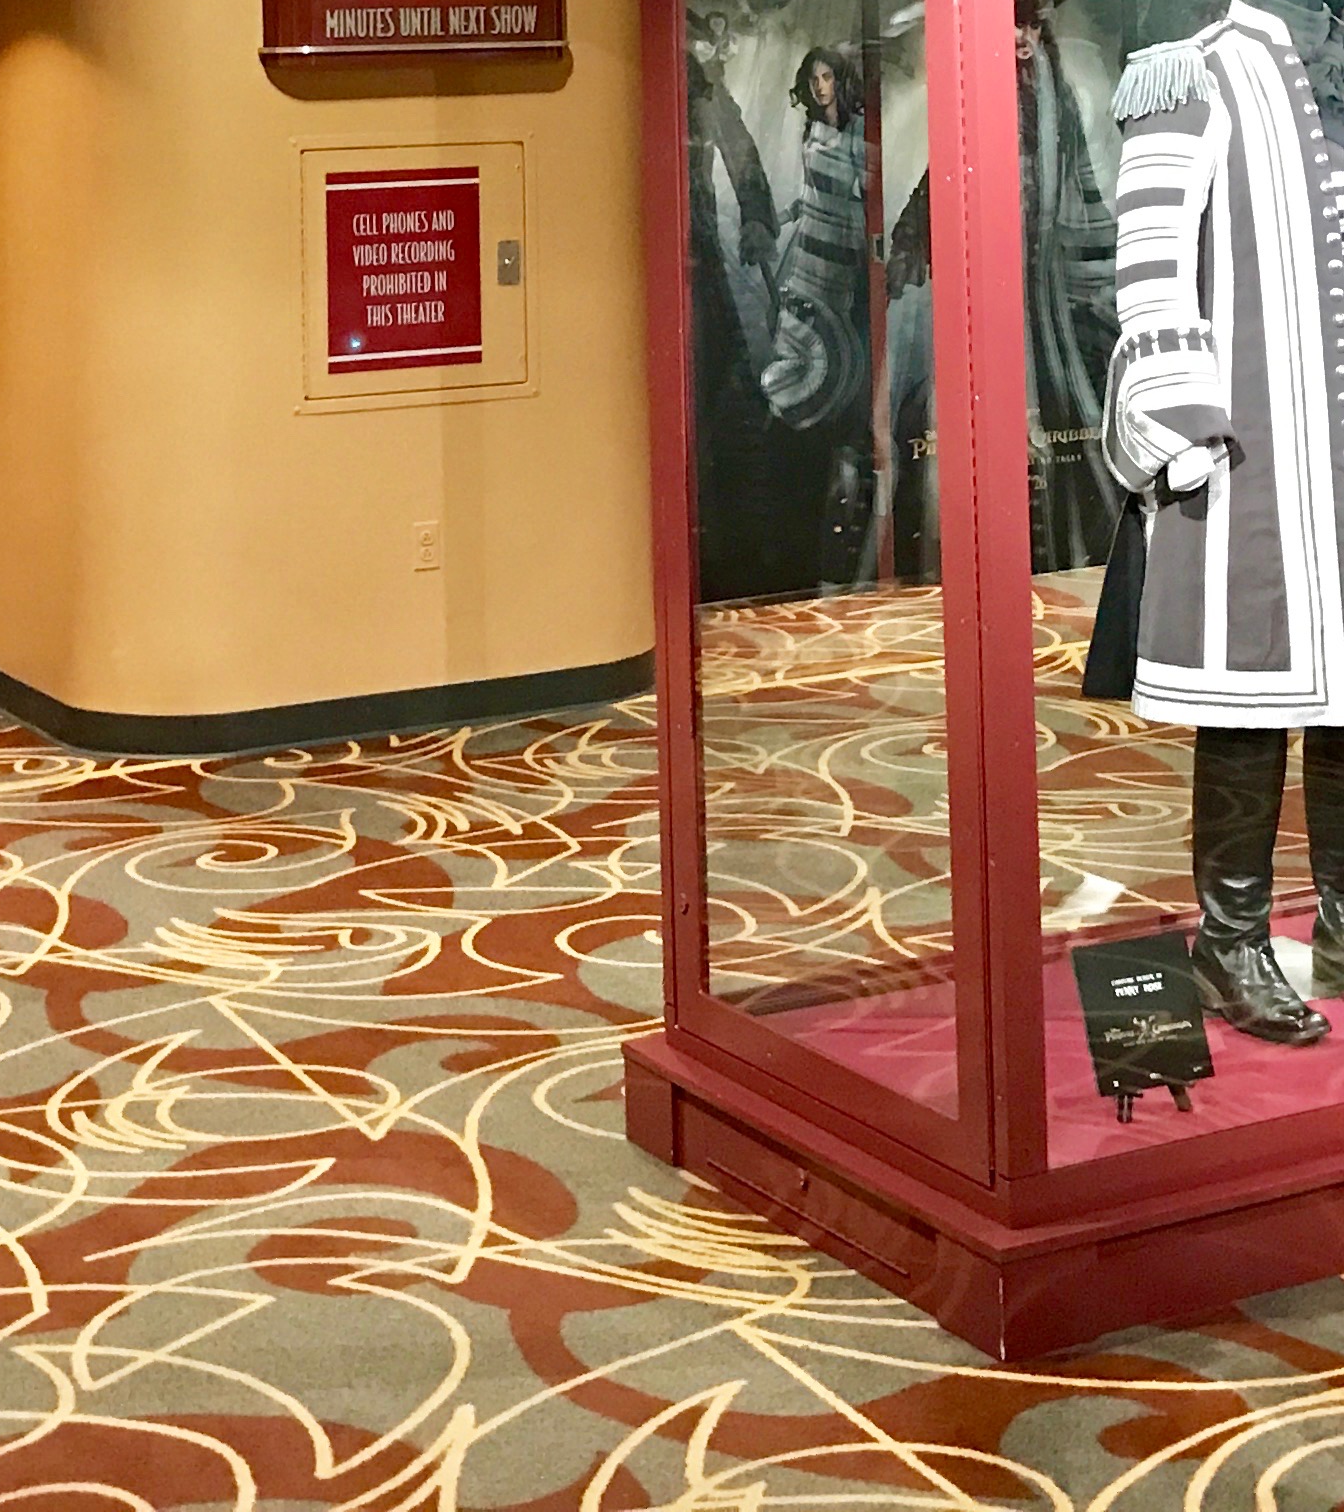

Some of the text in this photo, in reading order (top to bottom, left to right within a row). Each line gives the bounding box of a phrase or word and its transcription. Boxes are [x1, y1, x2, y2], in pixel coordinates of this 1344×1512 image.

[325, 4, 538, 39] MINUTES UNTIL NEXT SHOW
[352, 209, 455, 237] CELL PHONES AND
[352, 239, 455, 267] VIDEO RECORDING
[362, 270, 447, 297] PROHIBITED IN
[366, 300, 445, 327] THIS THEATER
